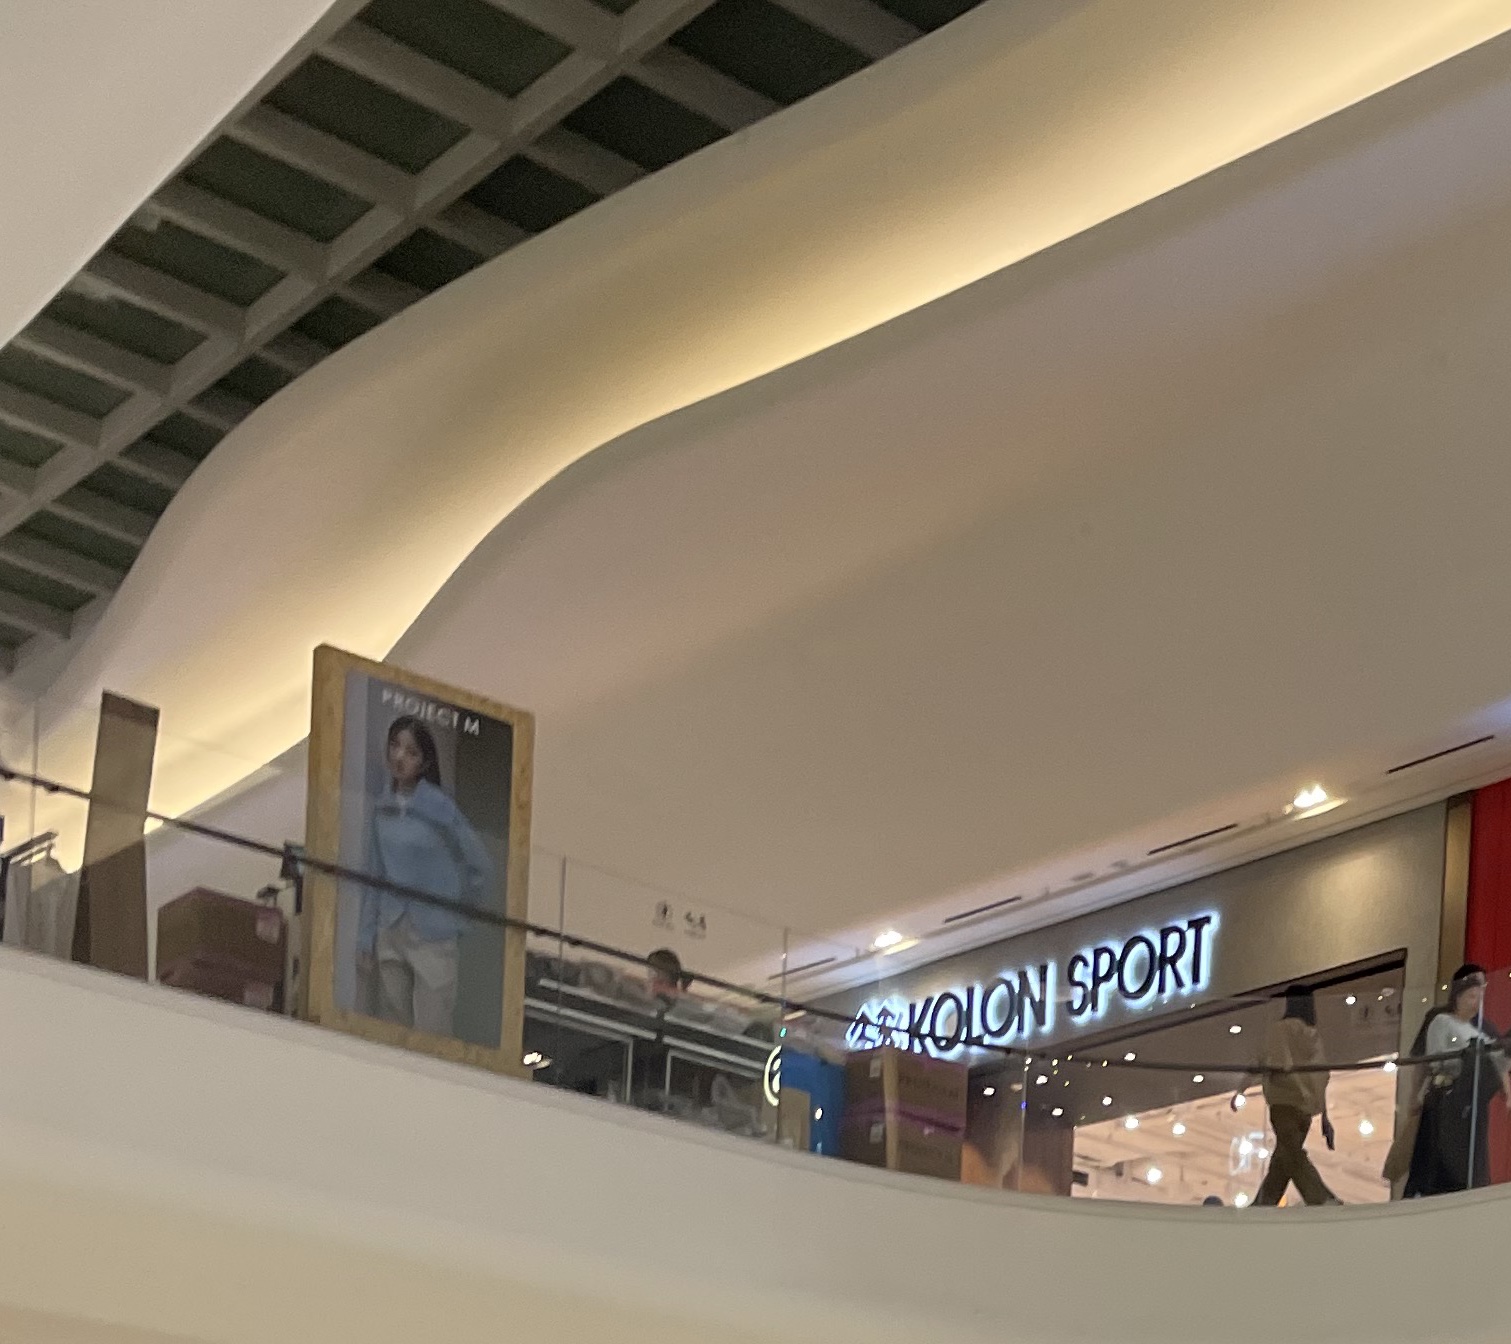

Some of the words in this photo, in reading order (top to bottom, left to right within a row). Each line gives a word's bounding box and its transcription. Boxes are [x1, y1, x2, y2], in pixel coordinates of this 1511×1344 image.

[382, 688, 460, 729] PROJECT
[463, 715, 480, 736] M
[908, 962, 1050, 1053] KOLON
[1066, 915, 1212, 1017] SPORT
